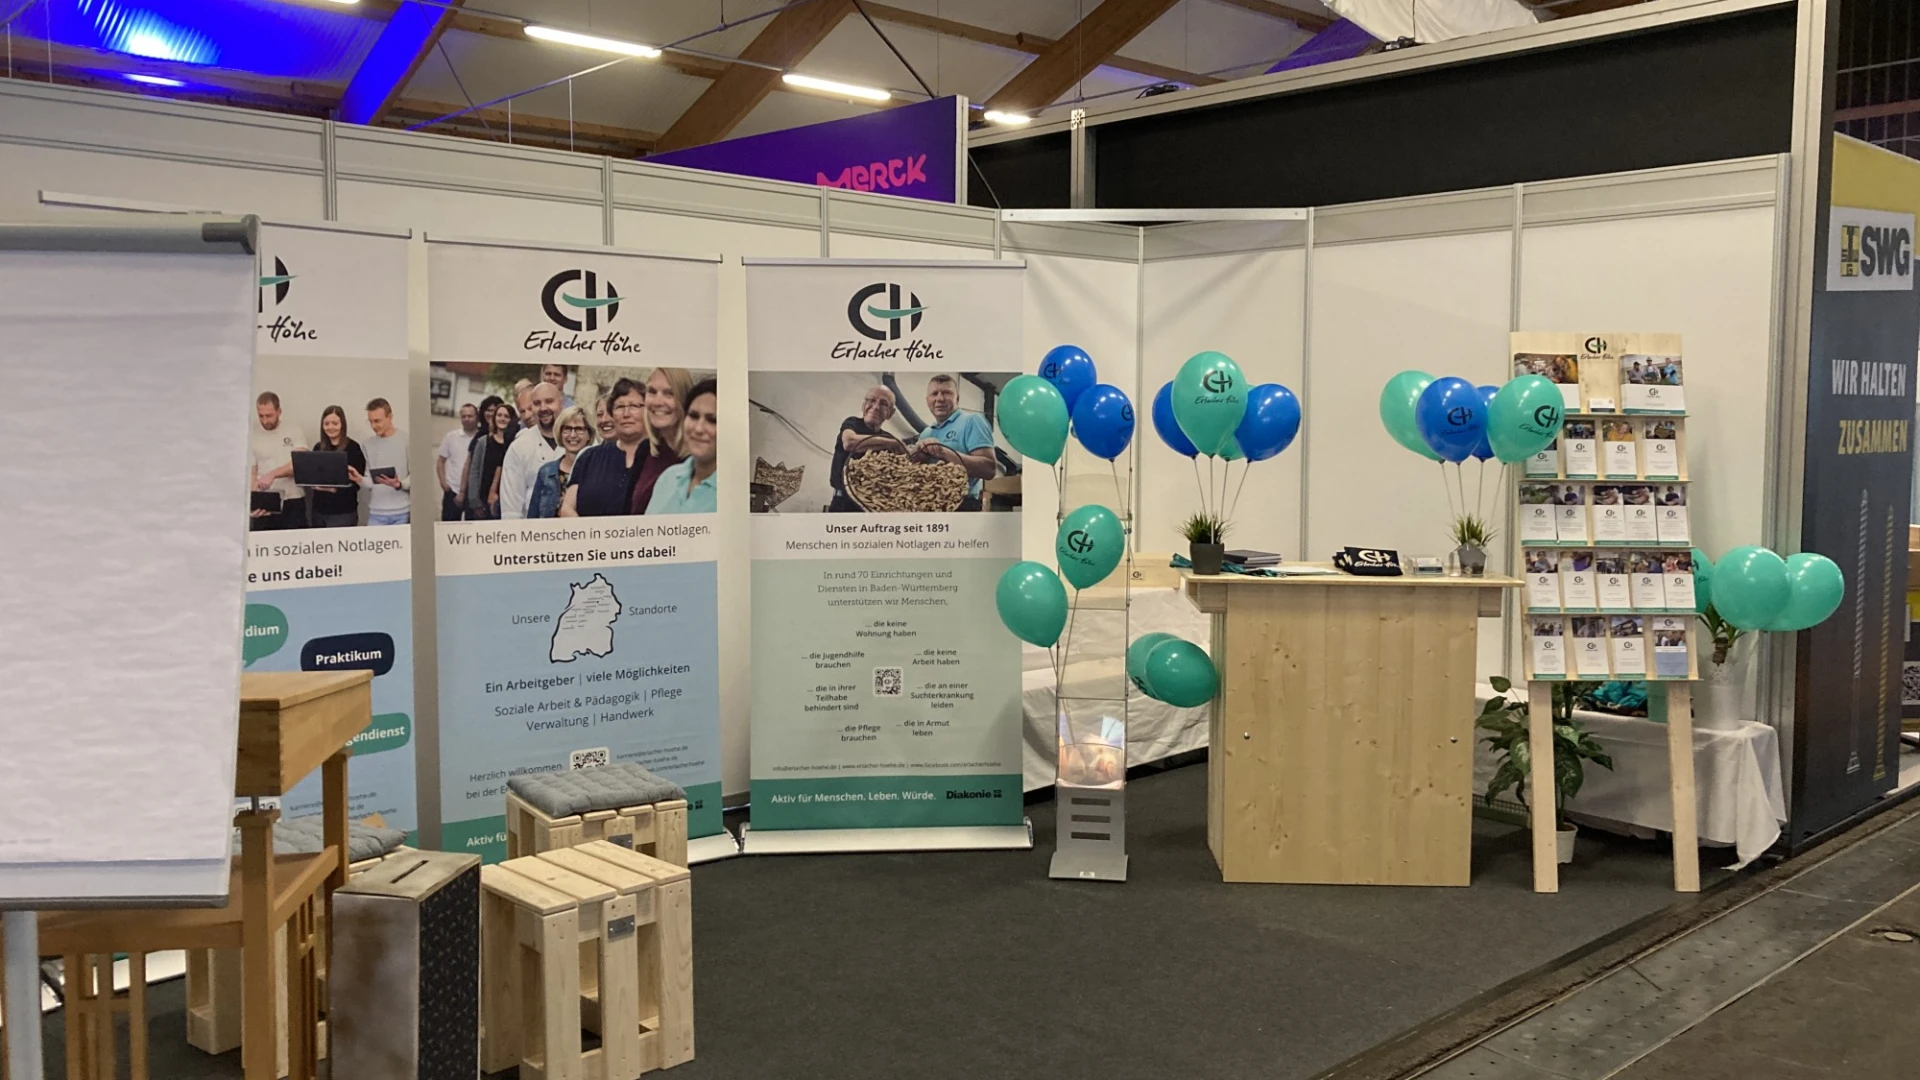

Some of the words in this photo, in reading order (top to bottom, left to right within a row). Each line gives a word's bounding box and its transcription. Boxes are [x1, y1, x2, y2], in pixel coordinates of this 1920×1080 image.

[1861, 225, 1911, 276] SWG
[267, 315, 318, 343] Höhe
[523, 331, 597, 352] Erlacher
[600, 331, 642, 356] Höhe
[831, 341, 900, 361] Erlacher
[903, 339, 944, 363] Höhe
[1832, 359, 1858, 395] WIR
[1860, 361, 1907, 397] HALTEN
[1838, 420, 1908, 455] ZUSAMMEN
[447, 533, 472, 545] Wir
[476, 530, 517, 544] helfen
[521, 527, 586, 543] Menschen
[589, 527, 601, 540] in
[604, 525, 654, 539] sozialen
[657, 523, 711, 538] Notlagen.
[825, 524, 858, 534] Unser
[860, 523, 901, 535] Auftrag
[904, 523, 923, 533] seit
[926, 523, 950, 533] 1891
[255, 544, 269, 557] in
[274, 541, 334, 556] sozialen
[338, 538, 403, 553] Notlagen.
[786, 540, 838, 550] Menschen
[840, 540, 850, 549] in
[852, 539, 894, 549] sozialen
[896, 539, 941, 551] Notlagen
[944, 541, 955, 549] zu
[958, 539, 989, 549] helfen
[493, 550, 584, 566] Unterstützen
[587, 548, 607, 562] Sie
[610, 549, 634, 560] uns
[637, 546, 676, 558] dabei!
[262, 571, 290, 582] uns
[295, 565, 343, 579] dabei!
[823, 571, 833, 579] In
[834, 570, 856, 579] rund
[858, 570, 869, 578] 70
[871, 570, 933, 580] Einrichtungen
[935, 570, 952, 578] und
[818, 584, 857, 593] Diensten
[859, 584, 868, 592] in
[870, 583, 958, 593] Baden-Württemberg
[828, 598, 882, 607] unterstützen
[884, 598, 900, 606] wir
[629, 603, 678, 616] Standorte
[512, 613, 551, 625] Unsere
[855, 630, 891, 638] Wohnung
[316, 649, 382, 665] Praktikum
[822, 651, 865, 660] Jugendhilfe
[815, 661, 851, 669] brauchen
[485, 681, 503, 693] Ein
[506, 674, 575, 691] Arbeitgeber
[586, 670, 612, 683] viele
[615, 664, 691, 682] Möglichkeiten
[828, 684, 835, 692] in
[494, 703, 534, 717] Soziale
[537, 698, 571, 712] Arbeit
[574, 697, 582, 708] &
[585, 690, 640, 708] Pädagogik
[651, 687, 683, 701] Pflege
[816, 693, 848, 702] Teilhabe
[910, 692, 974, 700] Suchterkrankung
[804, 703, 842, 712] behindert
[843, 703, 859, 711] sind
[526, 715, 589, 731] Verwaltung
[600, 707, 654, 723] Handwerk
[926, 719, 950, 727] Armut
[858, 724, 881, 733] Pflege
[841, 734, 877, 742] brauchen
[470, 770, 506, 782] Herzlich
[508, 763, 563, 776] willkommen
[466, 791, 480, 799] bei
[483, 787, 498, 796] der
[771, 794, 796, 804] Aktiv
[798, 793, 813, 803] für
[814, 792, 866, 802] Menschen.
[868, 791, 900, 801] Leben.
[902, 790, 937, 800] Würde.
[946, 790, 992, 800] Diakonie
[466, 834, 494, 848] Aktiv
